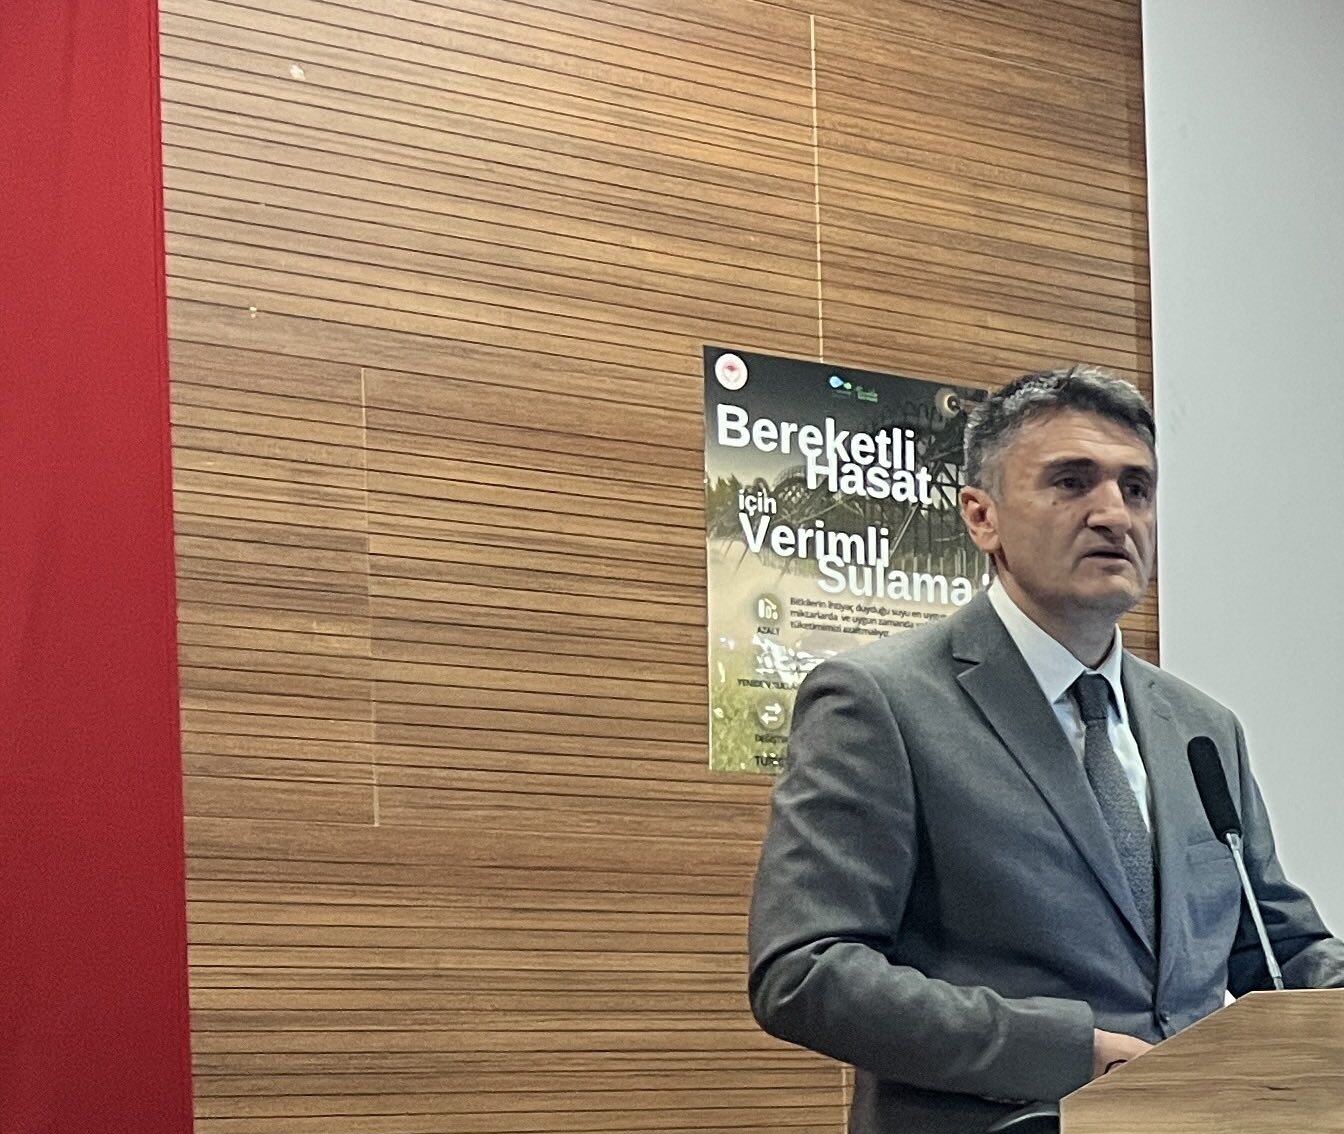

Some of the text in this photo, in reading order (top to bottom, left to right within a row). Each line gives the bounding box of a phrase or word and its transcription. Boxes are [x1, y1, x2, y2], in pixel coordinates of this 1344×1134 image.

[716, 403, 915, 472] Bereketli
[738, 489, 777, 516] için
[806, 449, 933, 506] Hasat
[738, 512, 890, 568] Verimli
[817, 555, 972, 606] Sulama
